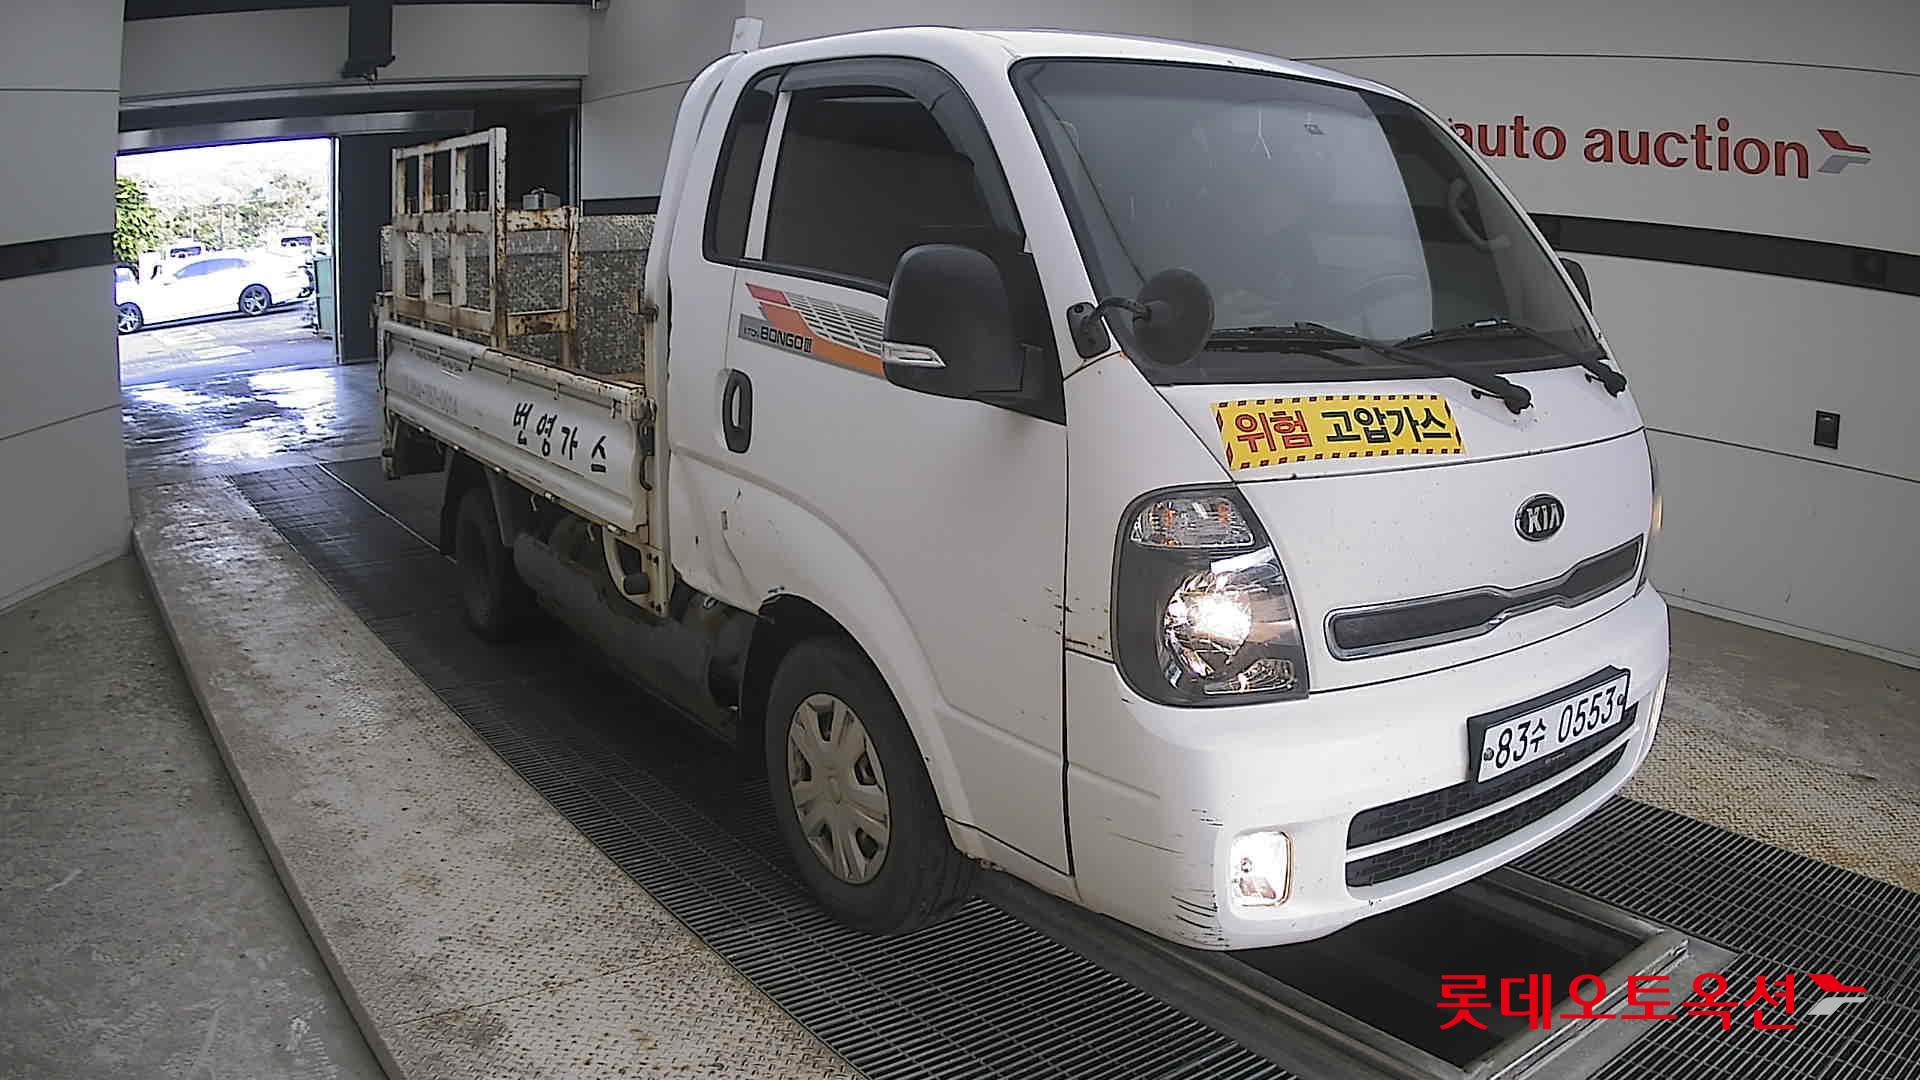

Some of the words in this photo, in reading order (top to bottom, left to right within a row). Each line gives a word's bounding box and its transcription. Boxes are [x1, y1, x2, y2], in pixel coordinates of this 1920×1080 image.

[1450, 115, 1567, 160] auto
[1583, 116, 1810, 179] auction
[760, 325, 804, 350] BONGO
[1234, 409, 1314, 453] 위험
[1320, 405, 1452, 444] 고압가스
[1526, 503, 1561, 533] KIA
[1495, 717, 1547, 769] 83수
[1557, 685, 1617, 744] 0553
